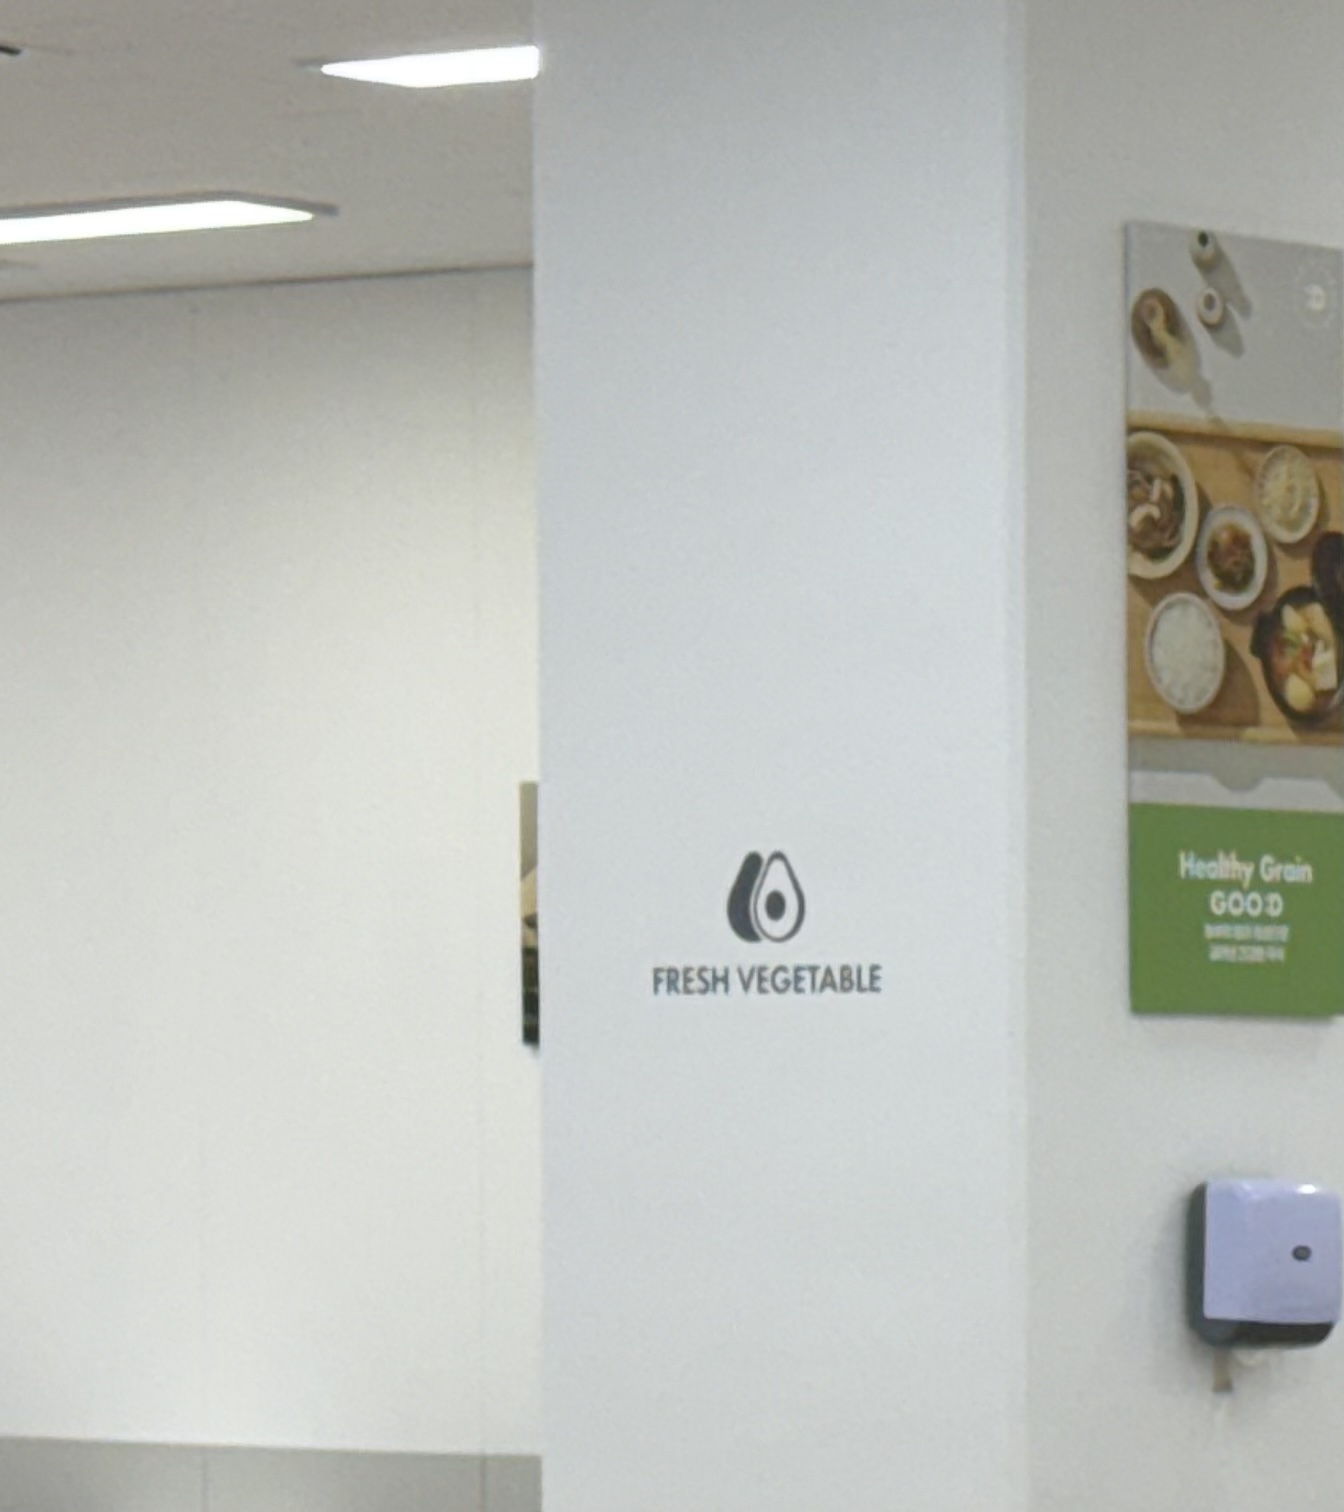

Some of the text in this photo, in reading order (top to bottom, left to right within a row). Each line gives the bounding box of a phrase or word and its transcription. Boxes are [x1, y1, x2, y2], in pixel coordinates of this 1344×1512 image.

[1178, 850, 1313, 889] Healthy Grain
[652, 963, 882, 996] FRESH VEGETABLE
